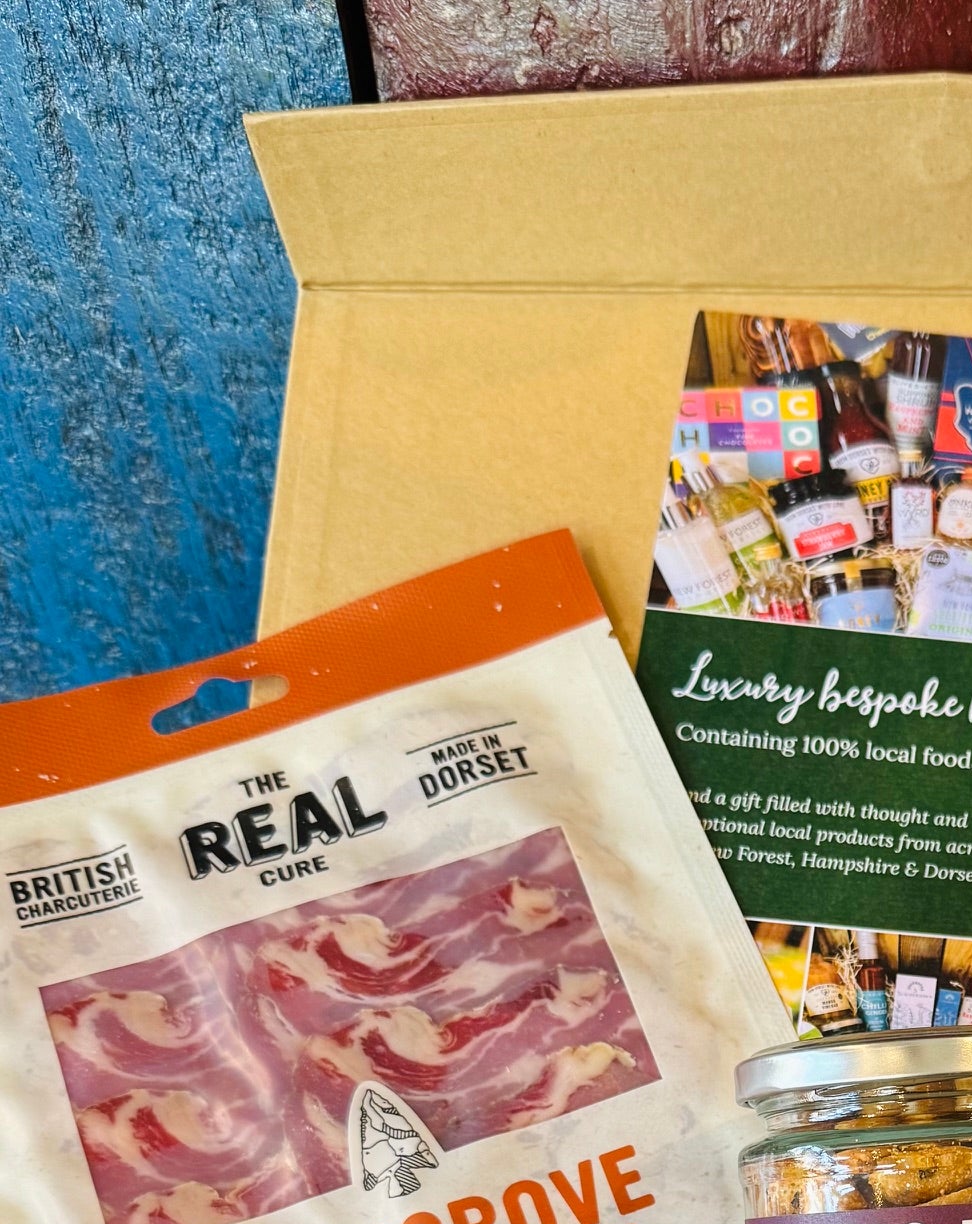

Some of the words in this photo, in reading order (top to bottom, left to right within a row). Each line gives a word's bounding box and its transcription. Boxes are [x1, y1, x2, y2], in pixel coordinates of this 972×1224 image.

[670, 649, 814, 725] Luxury
[817, 666, 965, 728] bespoke
[430, 738, 477, 766] MADE
[482, 734, 502, 751] IN
[675, 721, 798, 758] Containing
[802, 735, 860, 759] 100%
[865, 740, 917, 766] local
[239, 771, 290, 798] THE
[418, 746, 530, 800] DORSET
[179, 776, 388, 881] REAL
[730, 791, 763, 812] gift
[763, 794, 811, 815] filled
[815, 801, 855, 819] with
[860, 803, 930, 828] thought
[933, 811, 969, 829] and
[769, 820, 811, 841] local
[816, 828, 894, 849] products
[894, 834, 942, 855] from
[9, 851, 136, 904] BRITISH
[260, 855, 330, 887] CURE
[736, 845, 796, 869] Forest,
[801, 852, 901, 876] Hampshire
[16, 878, 142, 921] CHARCUTERIE
